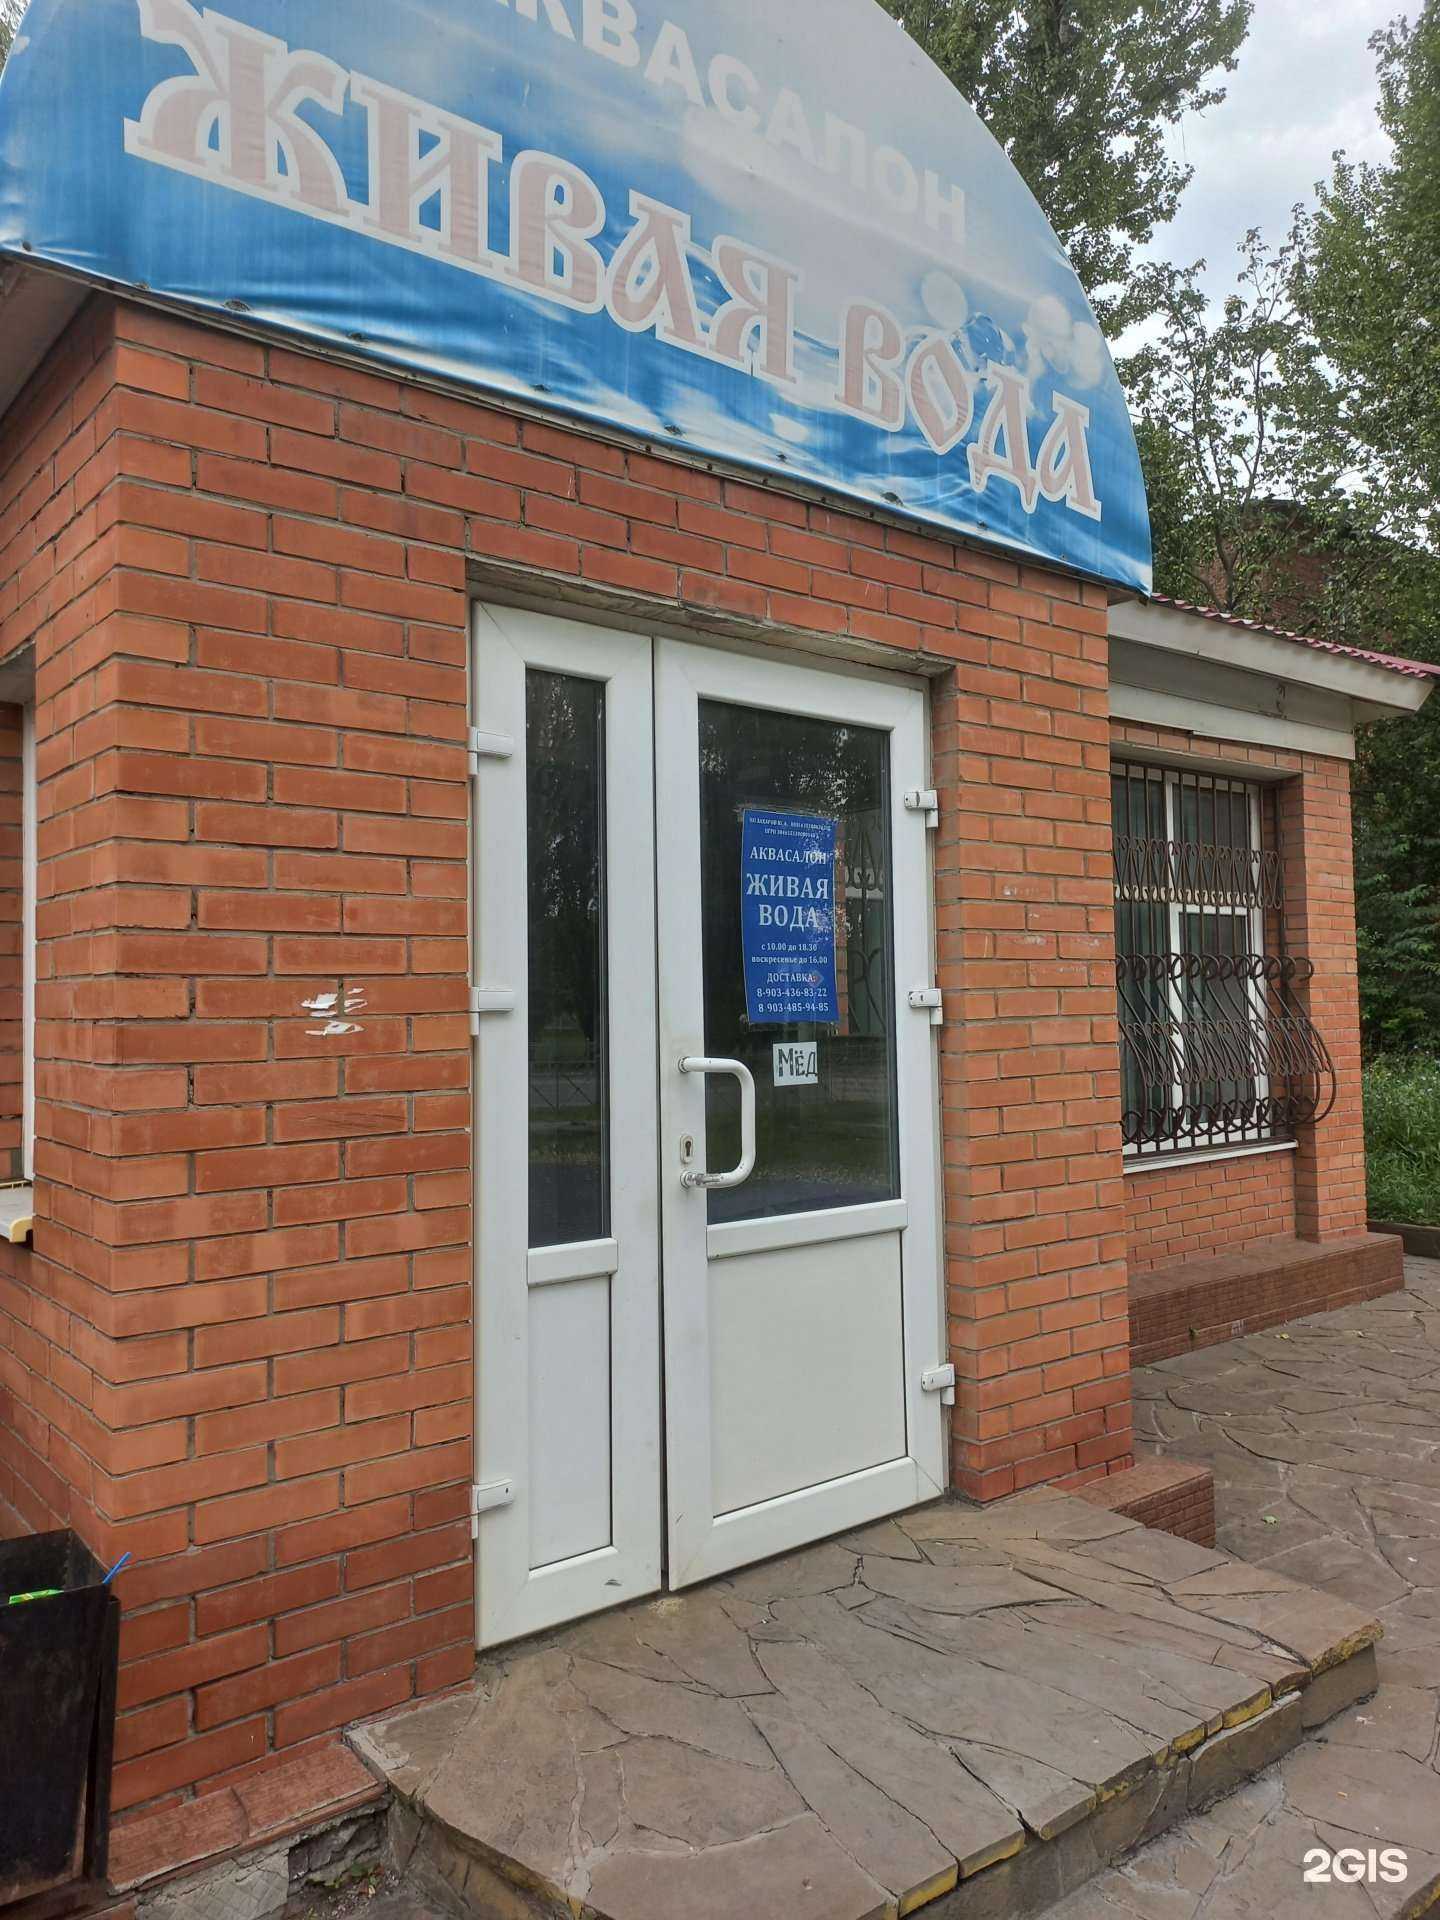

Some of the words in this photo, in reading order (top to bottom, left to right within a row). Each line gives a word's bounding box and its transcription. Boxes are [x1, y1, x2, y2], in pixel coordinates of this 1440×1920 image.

[496, 0, 966, 245] ВАСАЛОН
[124, 0, 799, 386] ЖИВАЯ
[834, 297, 1102, 522] ВОДА
[750, 846, 827, 865] АКВАСАЛОН
[746, 873, 829, 899] ЖИВАЯ
[759, 904, 819, 932] ВОДА
[752, 956, 797, 964] воскресенье
[788, 944, 796, 952] до
